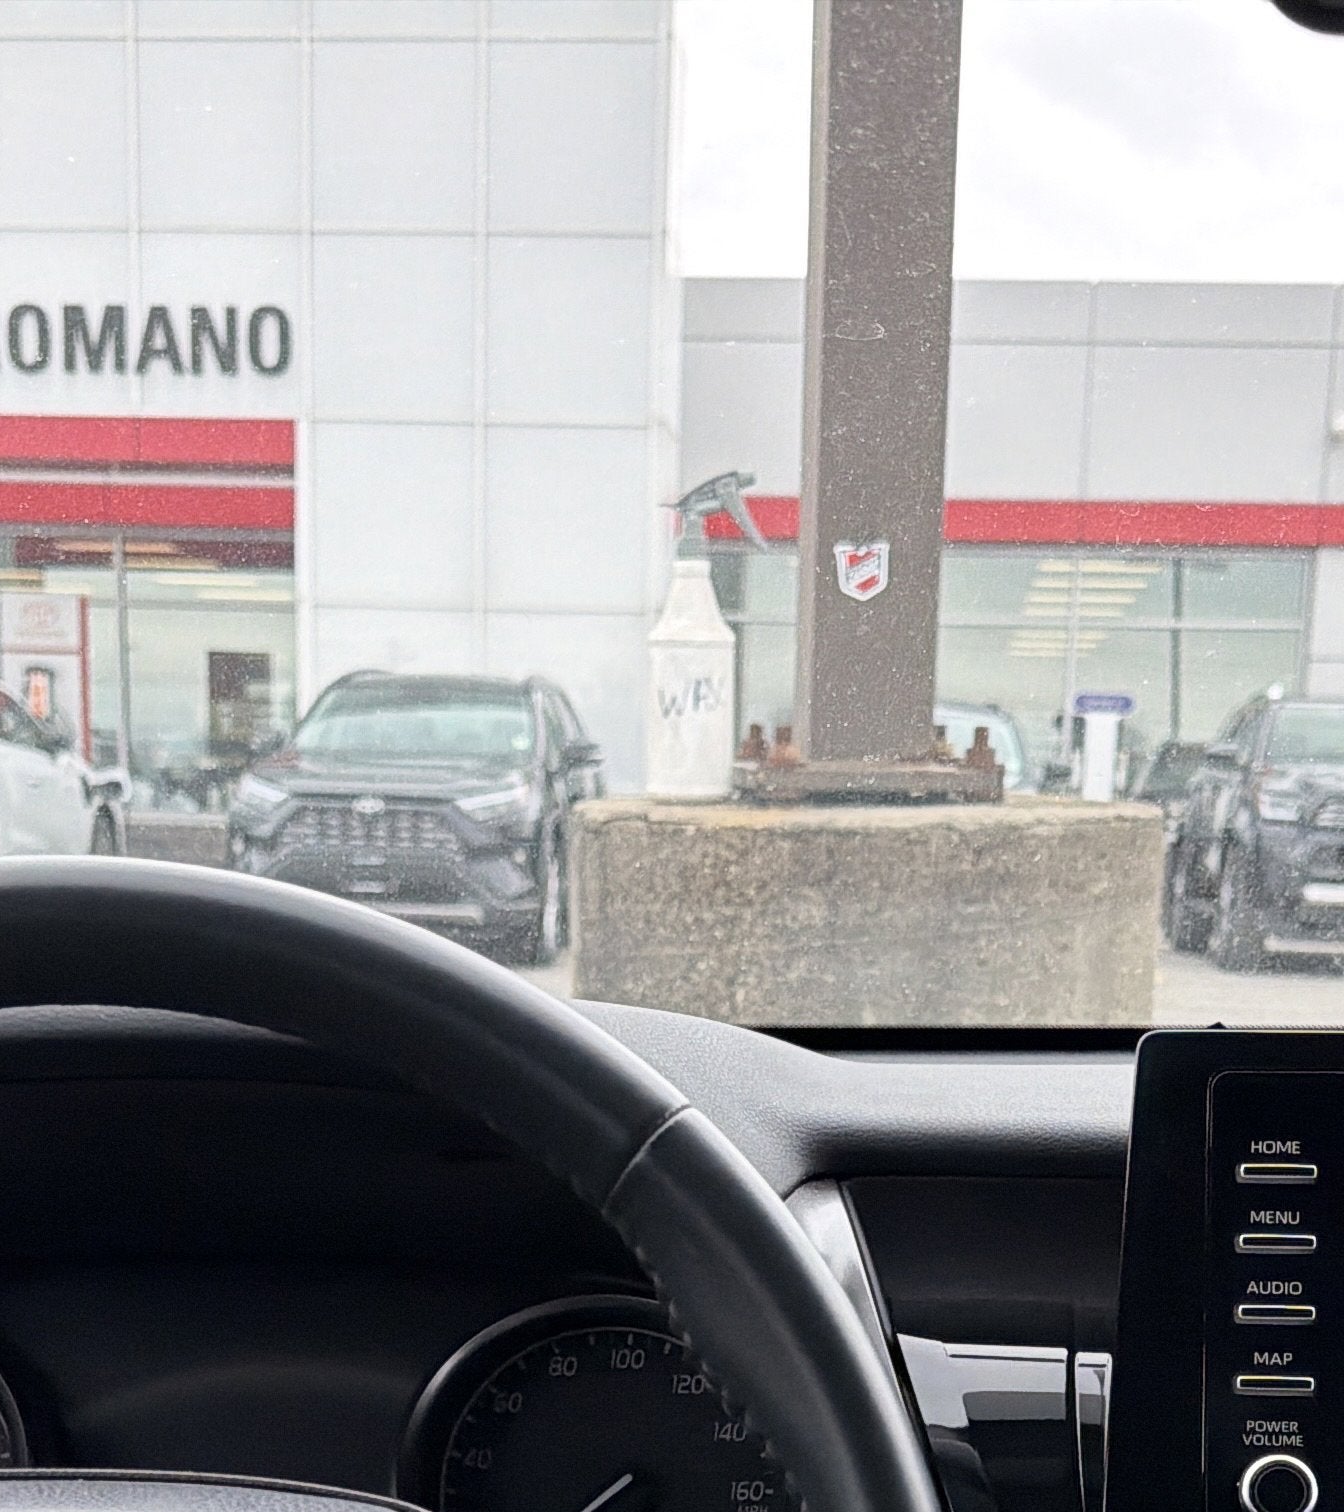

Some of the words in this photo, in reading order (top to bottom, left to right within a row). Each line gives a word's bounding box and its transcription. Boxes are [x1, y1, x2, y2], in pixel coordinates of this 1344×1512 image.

[1250, 1140, 1301, 1155] HOME
[1250, 1210, 1300, 1225] MENU
[1246, 1281, 1303, 1295] AUDIO
[610, 1348, 647, 1370] 100
[1253, 1351, 1293, 1366] MAP
[548, 1356, 578, 1377] 80
[671, 1373, 706, 1395] 120
[713, 1421, 746, 1443] 140
[1246, 1419, 1299, 1433] POWER
[1242, 1433, 1304, 1447] VOLUME
[730, 1480, 765, 1502] 160
